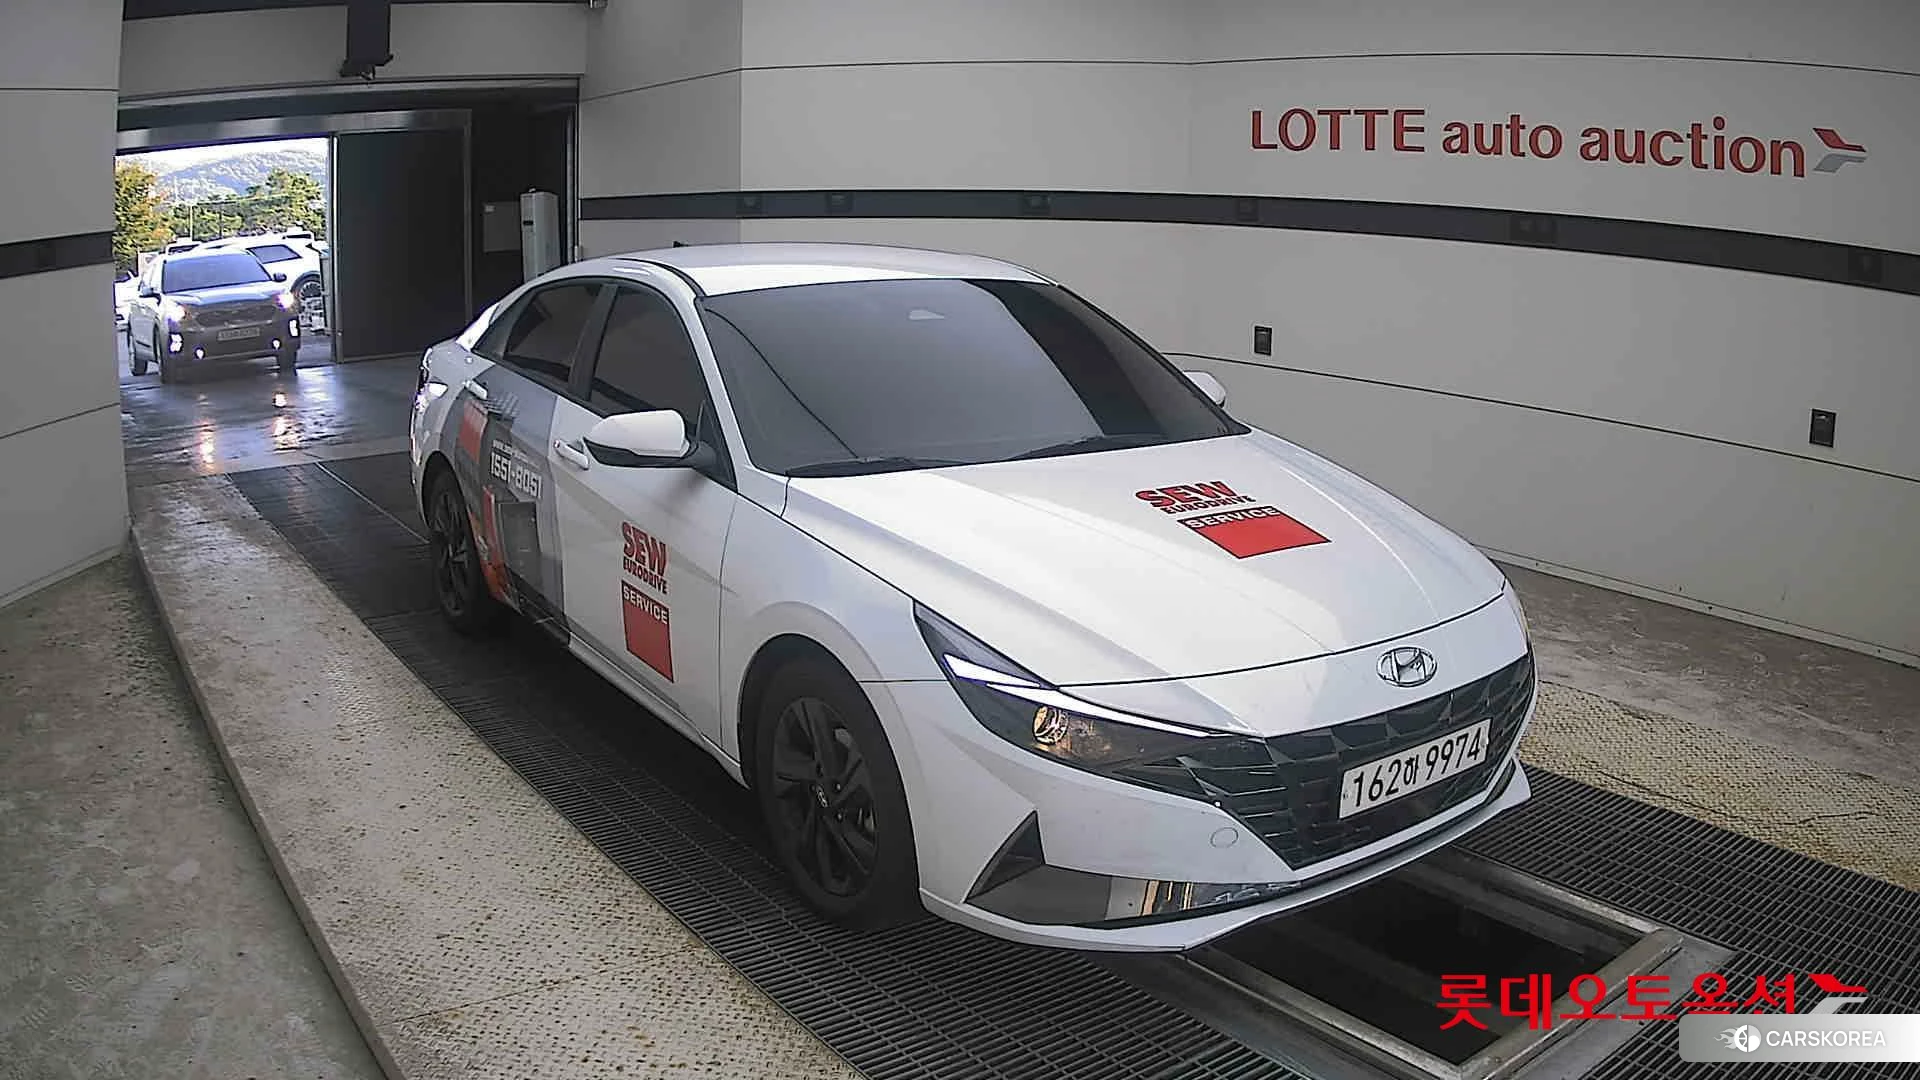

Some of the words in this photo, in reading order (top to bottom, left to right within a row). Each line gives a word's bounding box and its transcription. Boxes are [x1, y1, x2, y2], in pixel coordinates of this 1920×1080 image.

[1251, 107, 1425, 152] LOTTE
[1442, 114, 1563, 159] auto
[1579, 116, 1806, 178] auction
[1136, 480, 1238, 507] SEW
[1160, 494, 1257, 514] EURODRIVE
[1184, 506, 1282, 529] SERVICE
[621, 521, 666, 577] SEW
[623, 556, 668, 595] EURODRIVE
[623, 585, 669, 624] SERVICE
